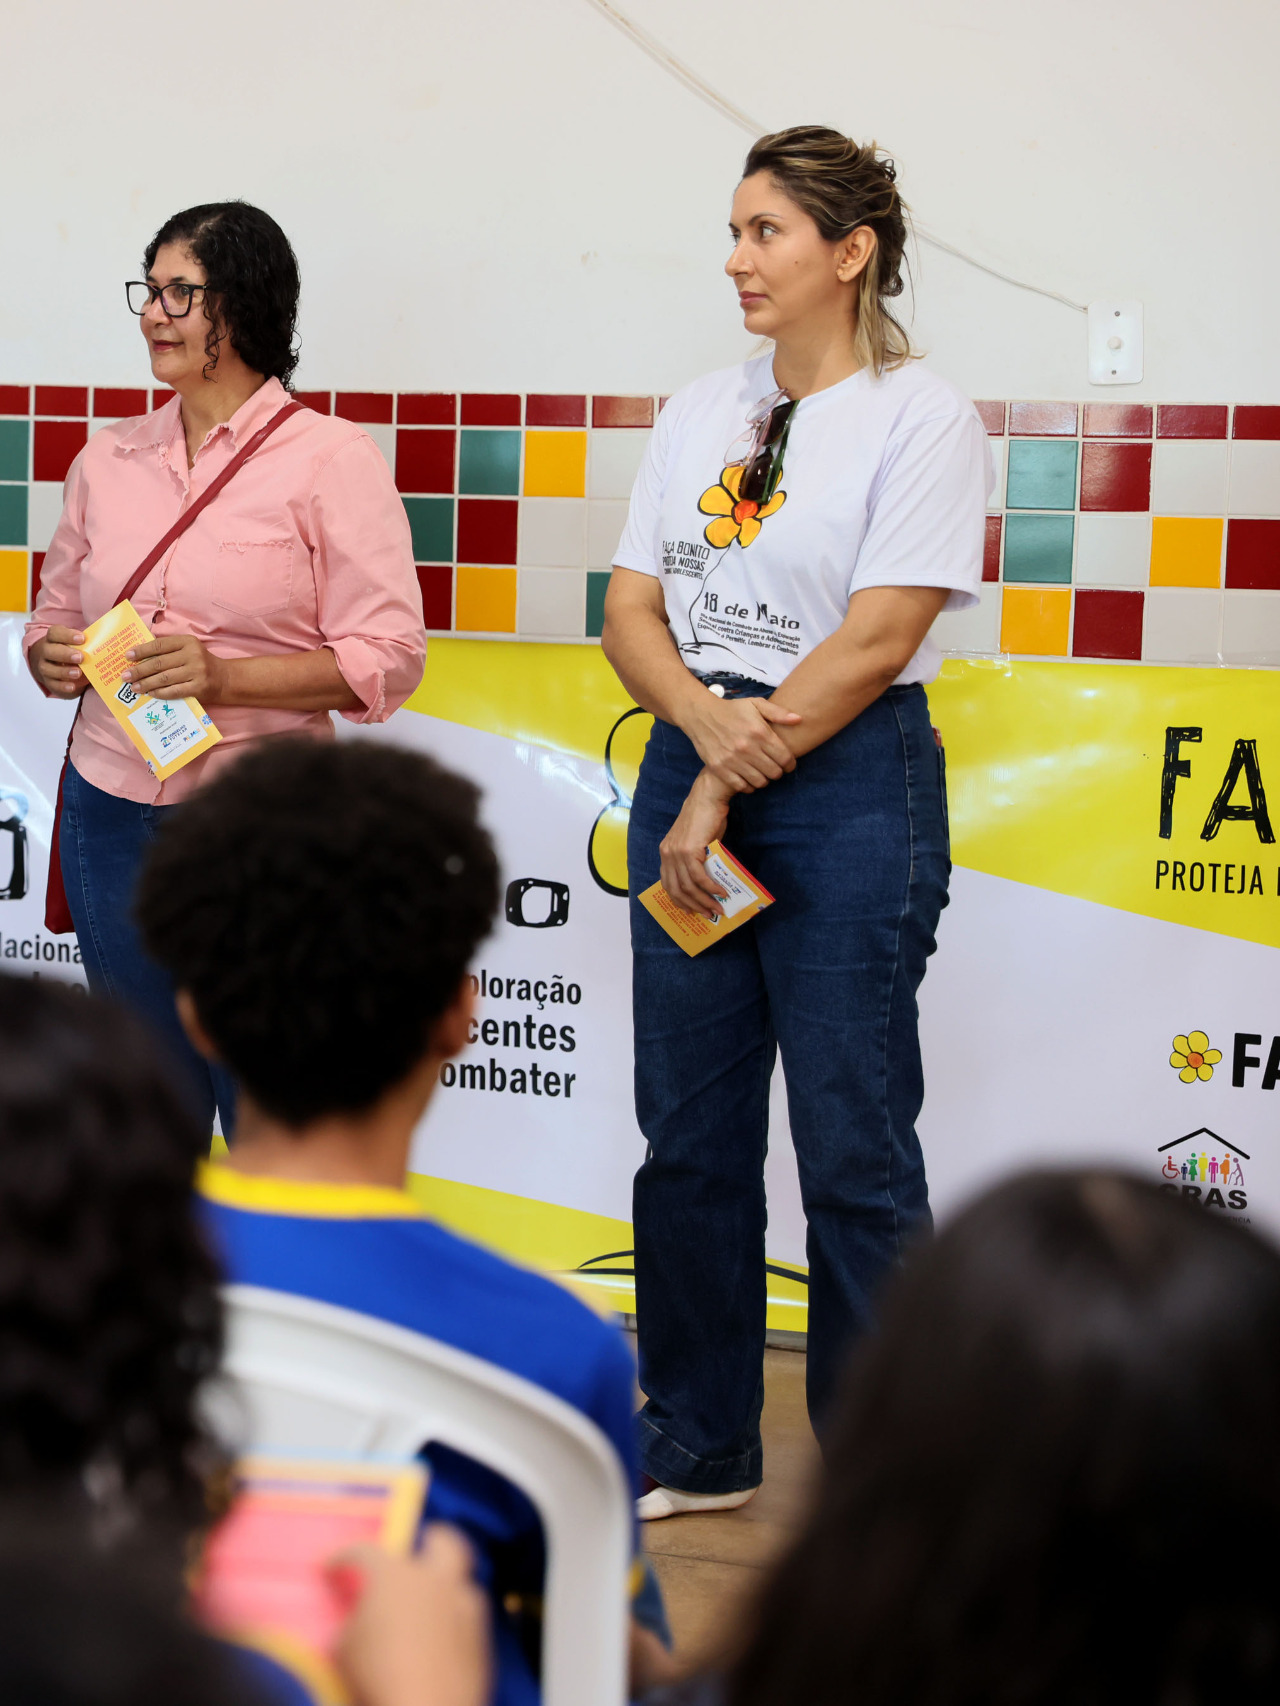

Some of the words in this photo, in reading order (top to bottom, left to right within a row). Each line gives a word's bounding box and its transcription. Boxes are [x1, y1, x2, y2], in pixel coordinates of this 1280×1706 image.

[677, 541, 710, 560] BONITO
[678, 557, 705, 572] NOSSAS
[704, 591, 718, 613] 18
[724, 603, 749, 619] de
[756, 600, 800, 630] Maio
[1155, 860, 1263, 895] PROTEJA
[464, 1014, 576, 1052] centes
[439, 1058, 576, 1098] ombater
